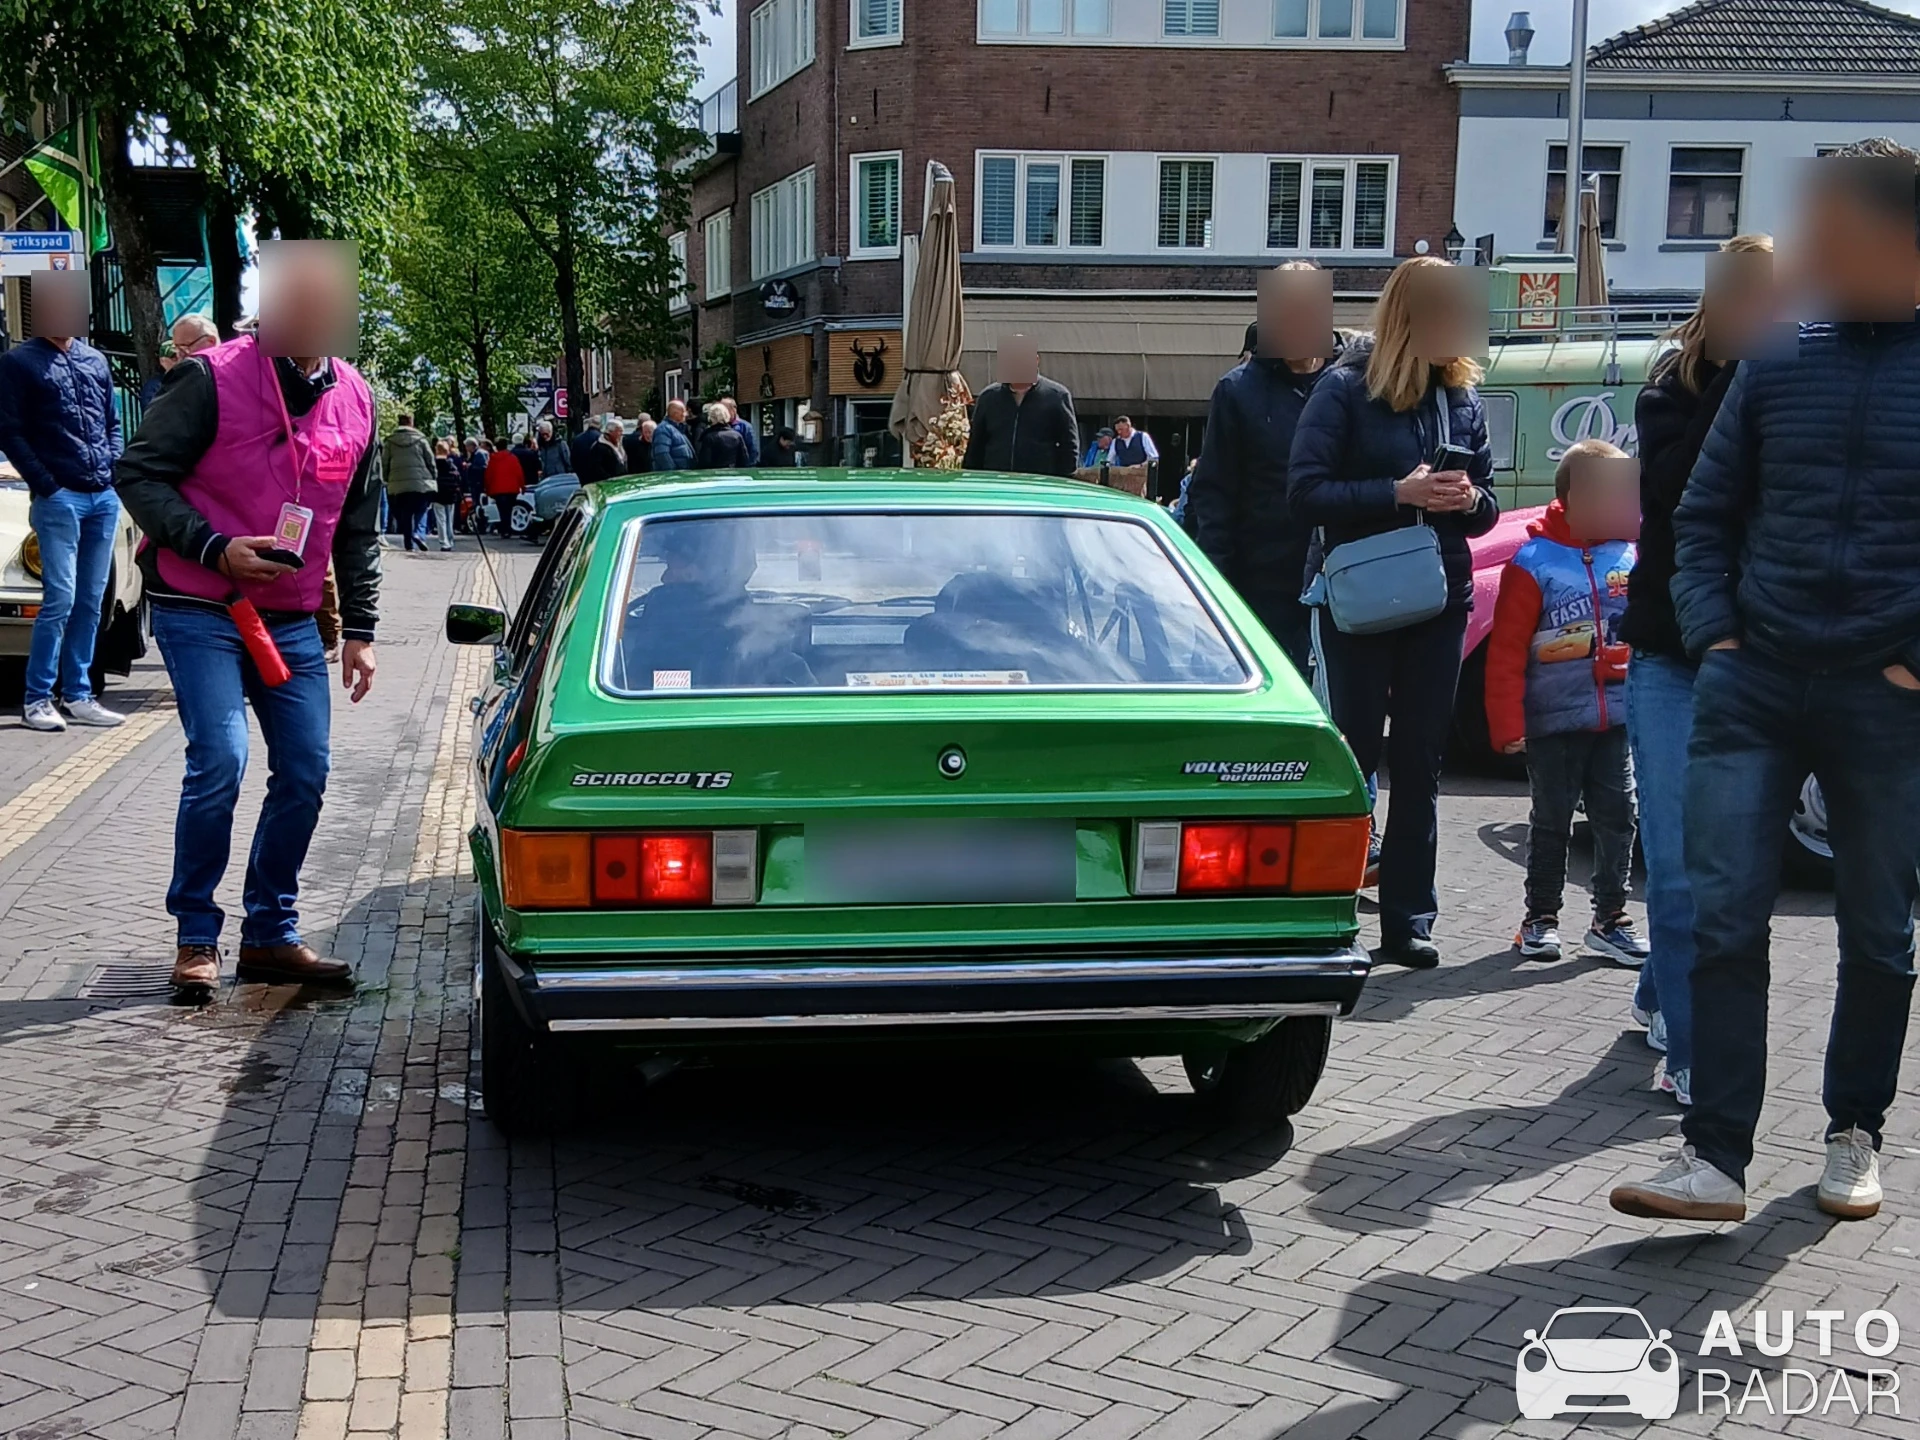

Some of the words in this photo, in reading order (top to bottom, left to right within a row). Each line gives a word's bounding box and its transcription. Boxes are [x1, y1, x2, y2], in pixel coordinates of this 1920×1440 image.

[6, 236, 63, 248] erikspad
[1550, 597, 1593, 627] FAST!
[1184, 761, 1309, 773] VOLKSWAGEN
[572, 772, 691, 786] SCIROCCO
[695, 772, 733, 788] TS
[1219, 773, 1304, 782] automatic
